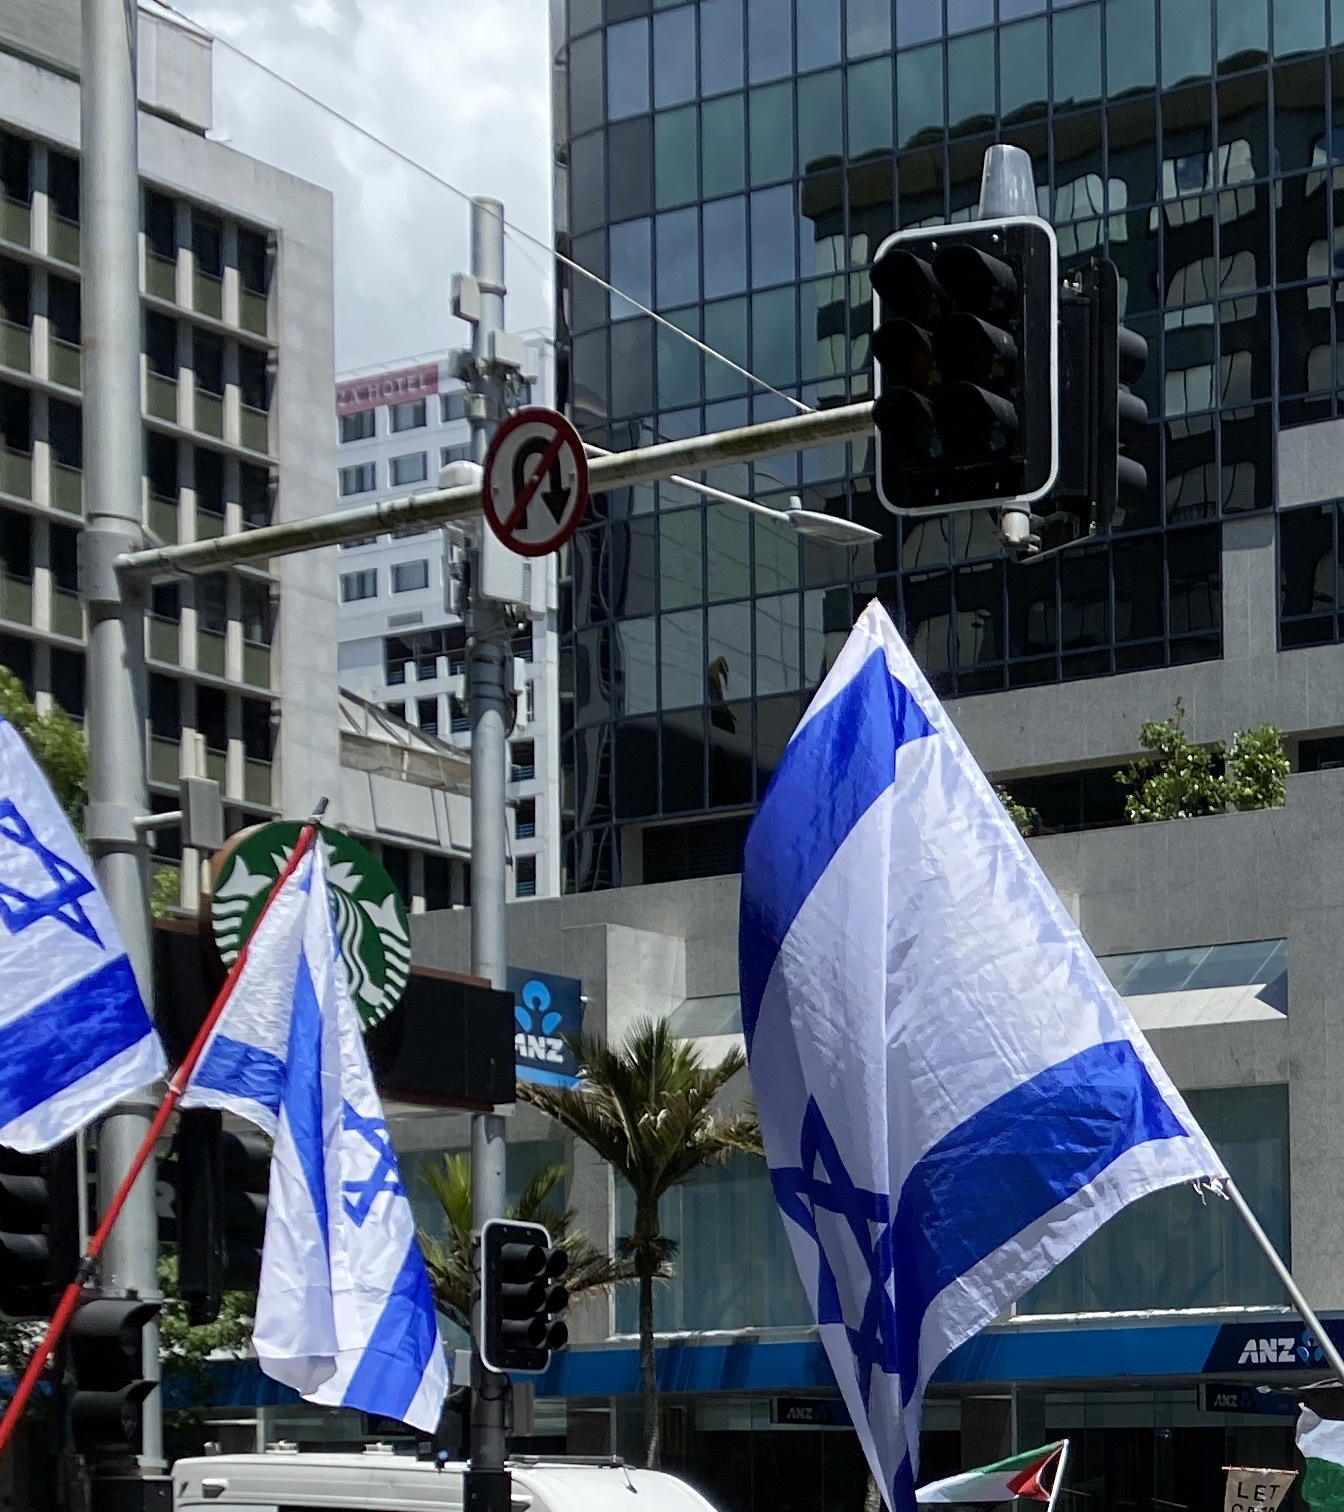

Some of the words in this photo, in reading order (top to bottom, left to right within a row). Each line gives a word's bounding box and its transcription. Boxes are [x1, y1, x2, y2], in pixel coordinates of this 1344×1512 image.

[335, 388, 361, 406] ZA
[369, 372, 428, 402] HOTEL
[515, 1033, 564, 1064] ANZ
[1238, 1338, 1296, 1364] ANZ
[1213, 1393, 1238, 1408] ANZ
[786, 1407, 813, 1420] ANZ
[1237, 1481, 1280, 1502] LET
